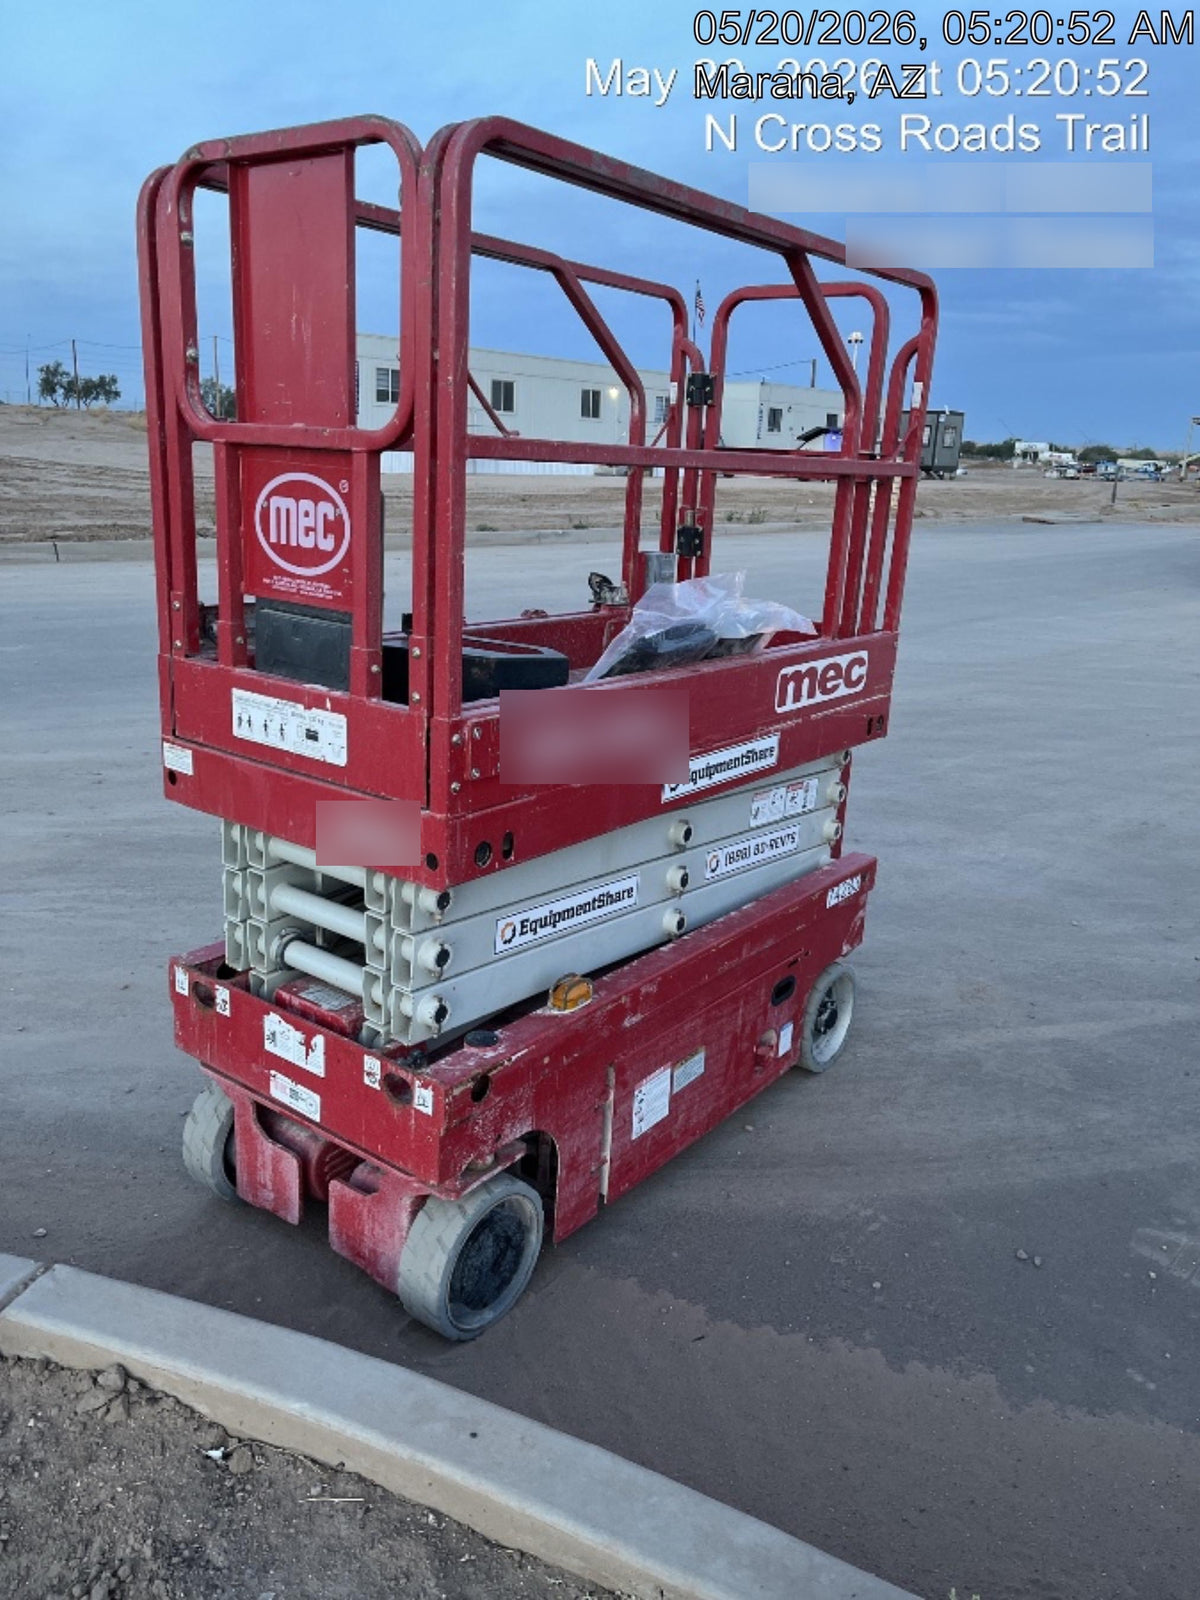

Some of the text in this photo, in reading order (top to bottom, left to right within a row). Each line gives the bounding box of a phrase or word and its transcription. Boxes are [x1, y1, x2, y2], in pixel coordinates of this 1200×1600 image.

[777, 656, 866, 708] mec
[689, 745, 775, 786] quipmentShare
[519, 886, 634, 937] EquipmentShare
